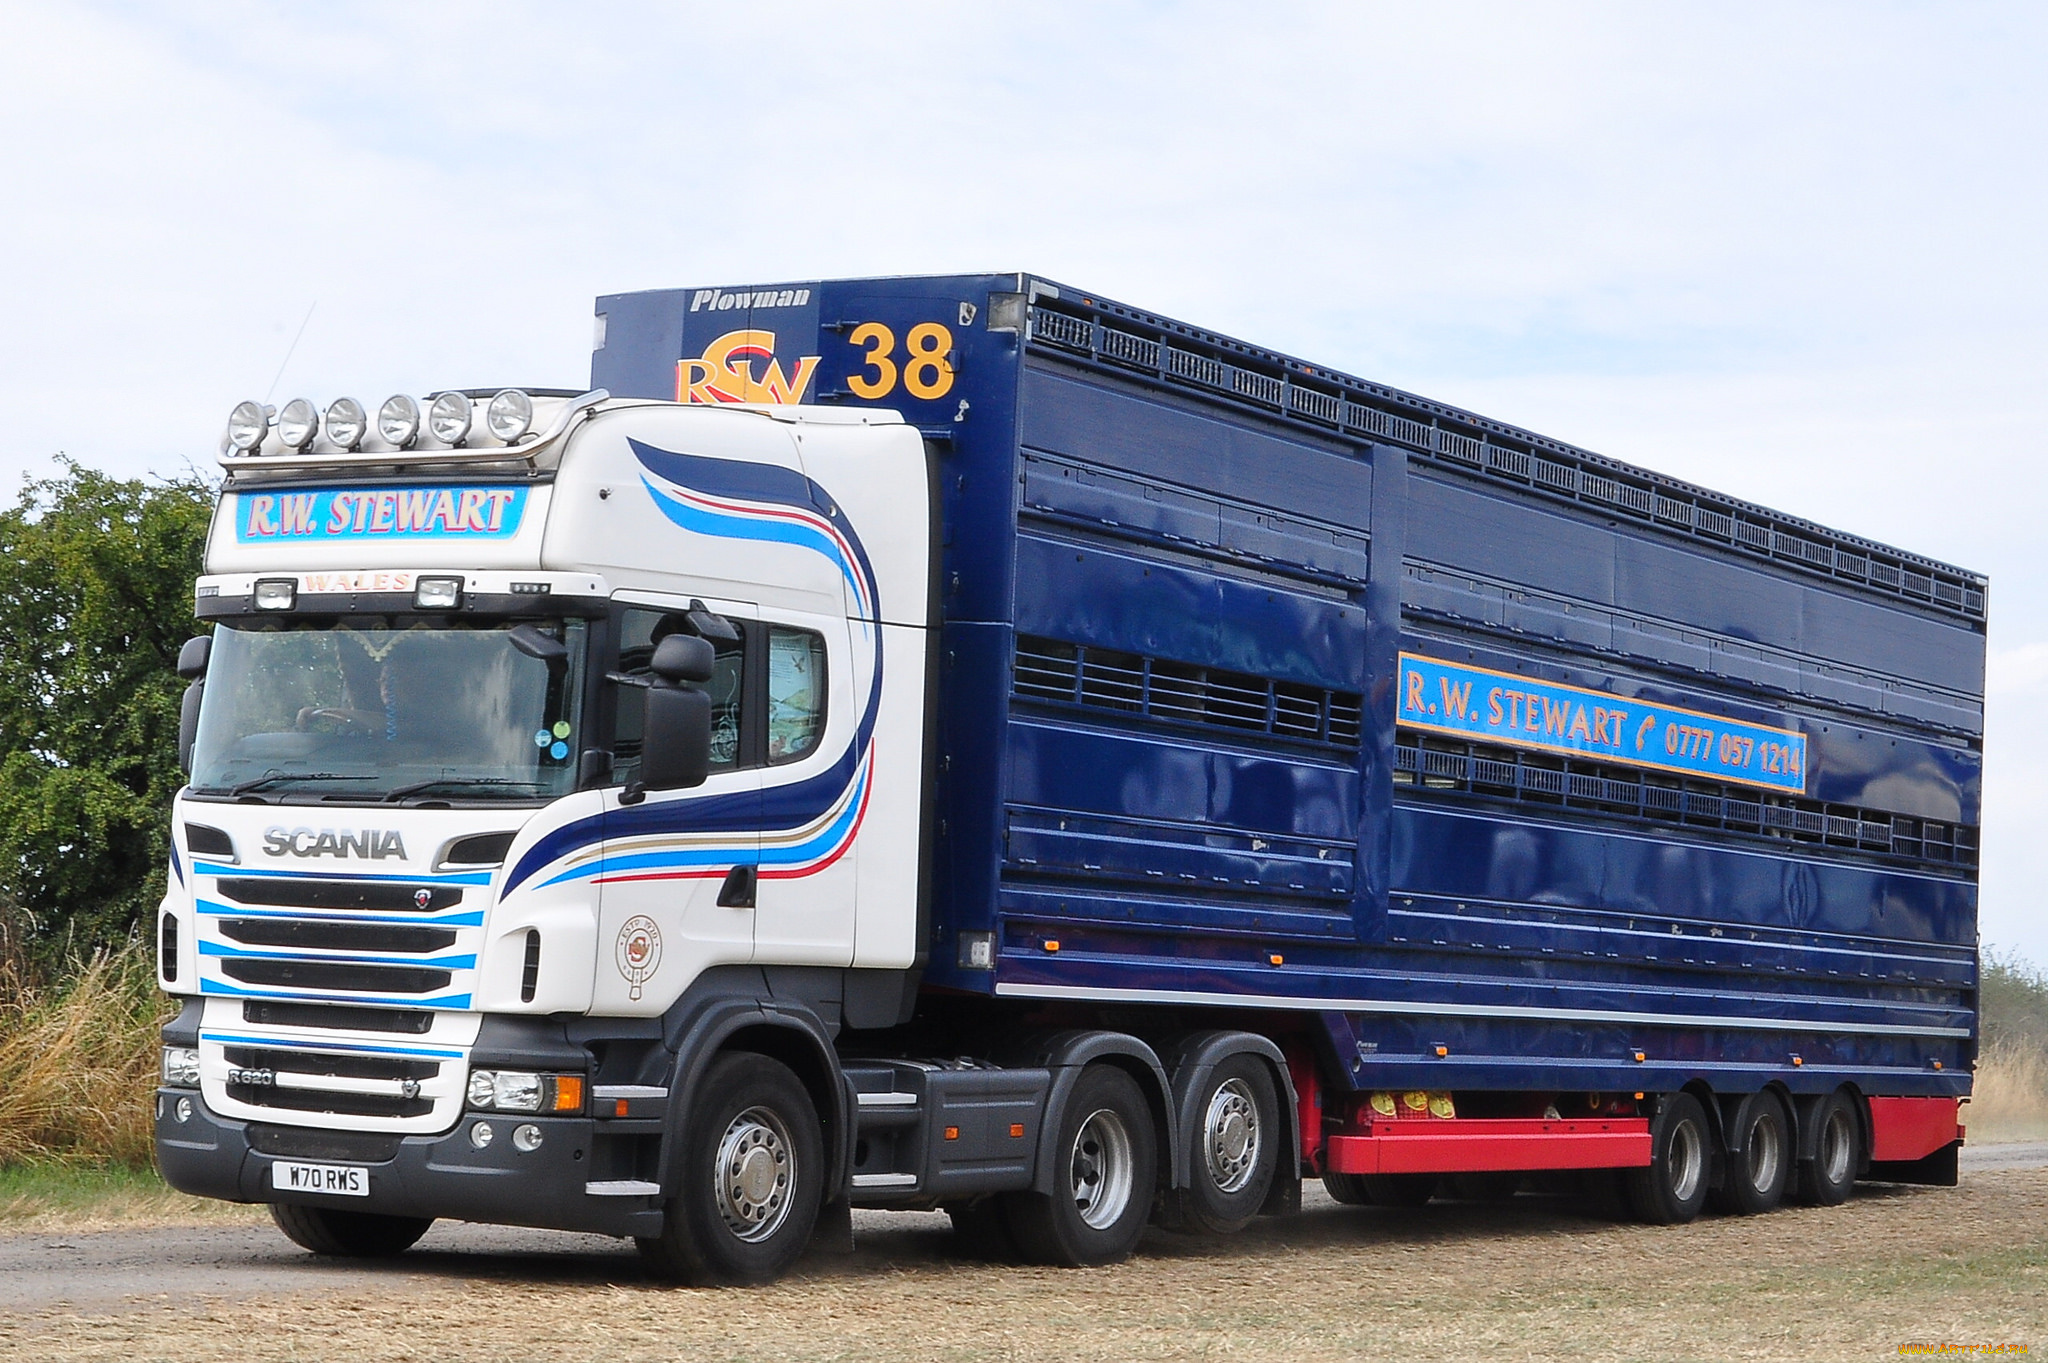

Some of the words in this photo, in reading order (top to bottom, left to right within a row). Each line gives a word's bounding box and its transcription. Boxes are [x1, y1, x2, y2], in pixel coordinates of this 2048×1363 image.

[690, 289, 810, 312] Plowman
[847, 322, 954, 399] 38
[327, 490, 514, 533] STEWART
[305, 574, 411, 592] WALES
[1488, 687, 1628, 747] STEWART
[1666, 723, 1714, 760] 0777
[1719, 733, 1754, 768] 057
[1759, 741, 1800, 777] 1214
[262, 825, 408, 860] SCANIA
[290, 1167, 321, 1187] W70
[327, 1170, 359, 1191] RWS
